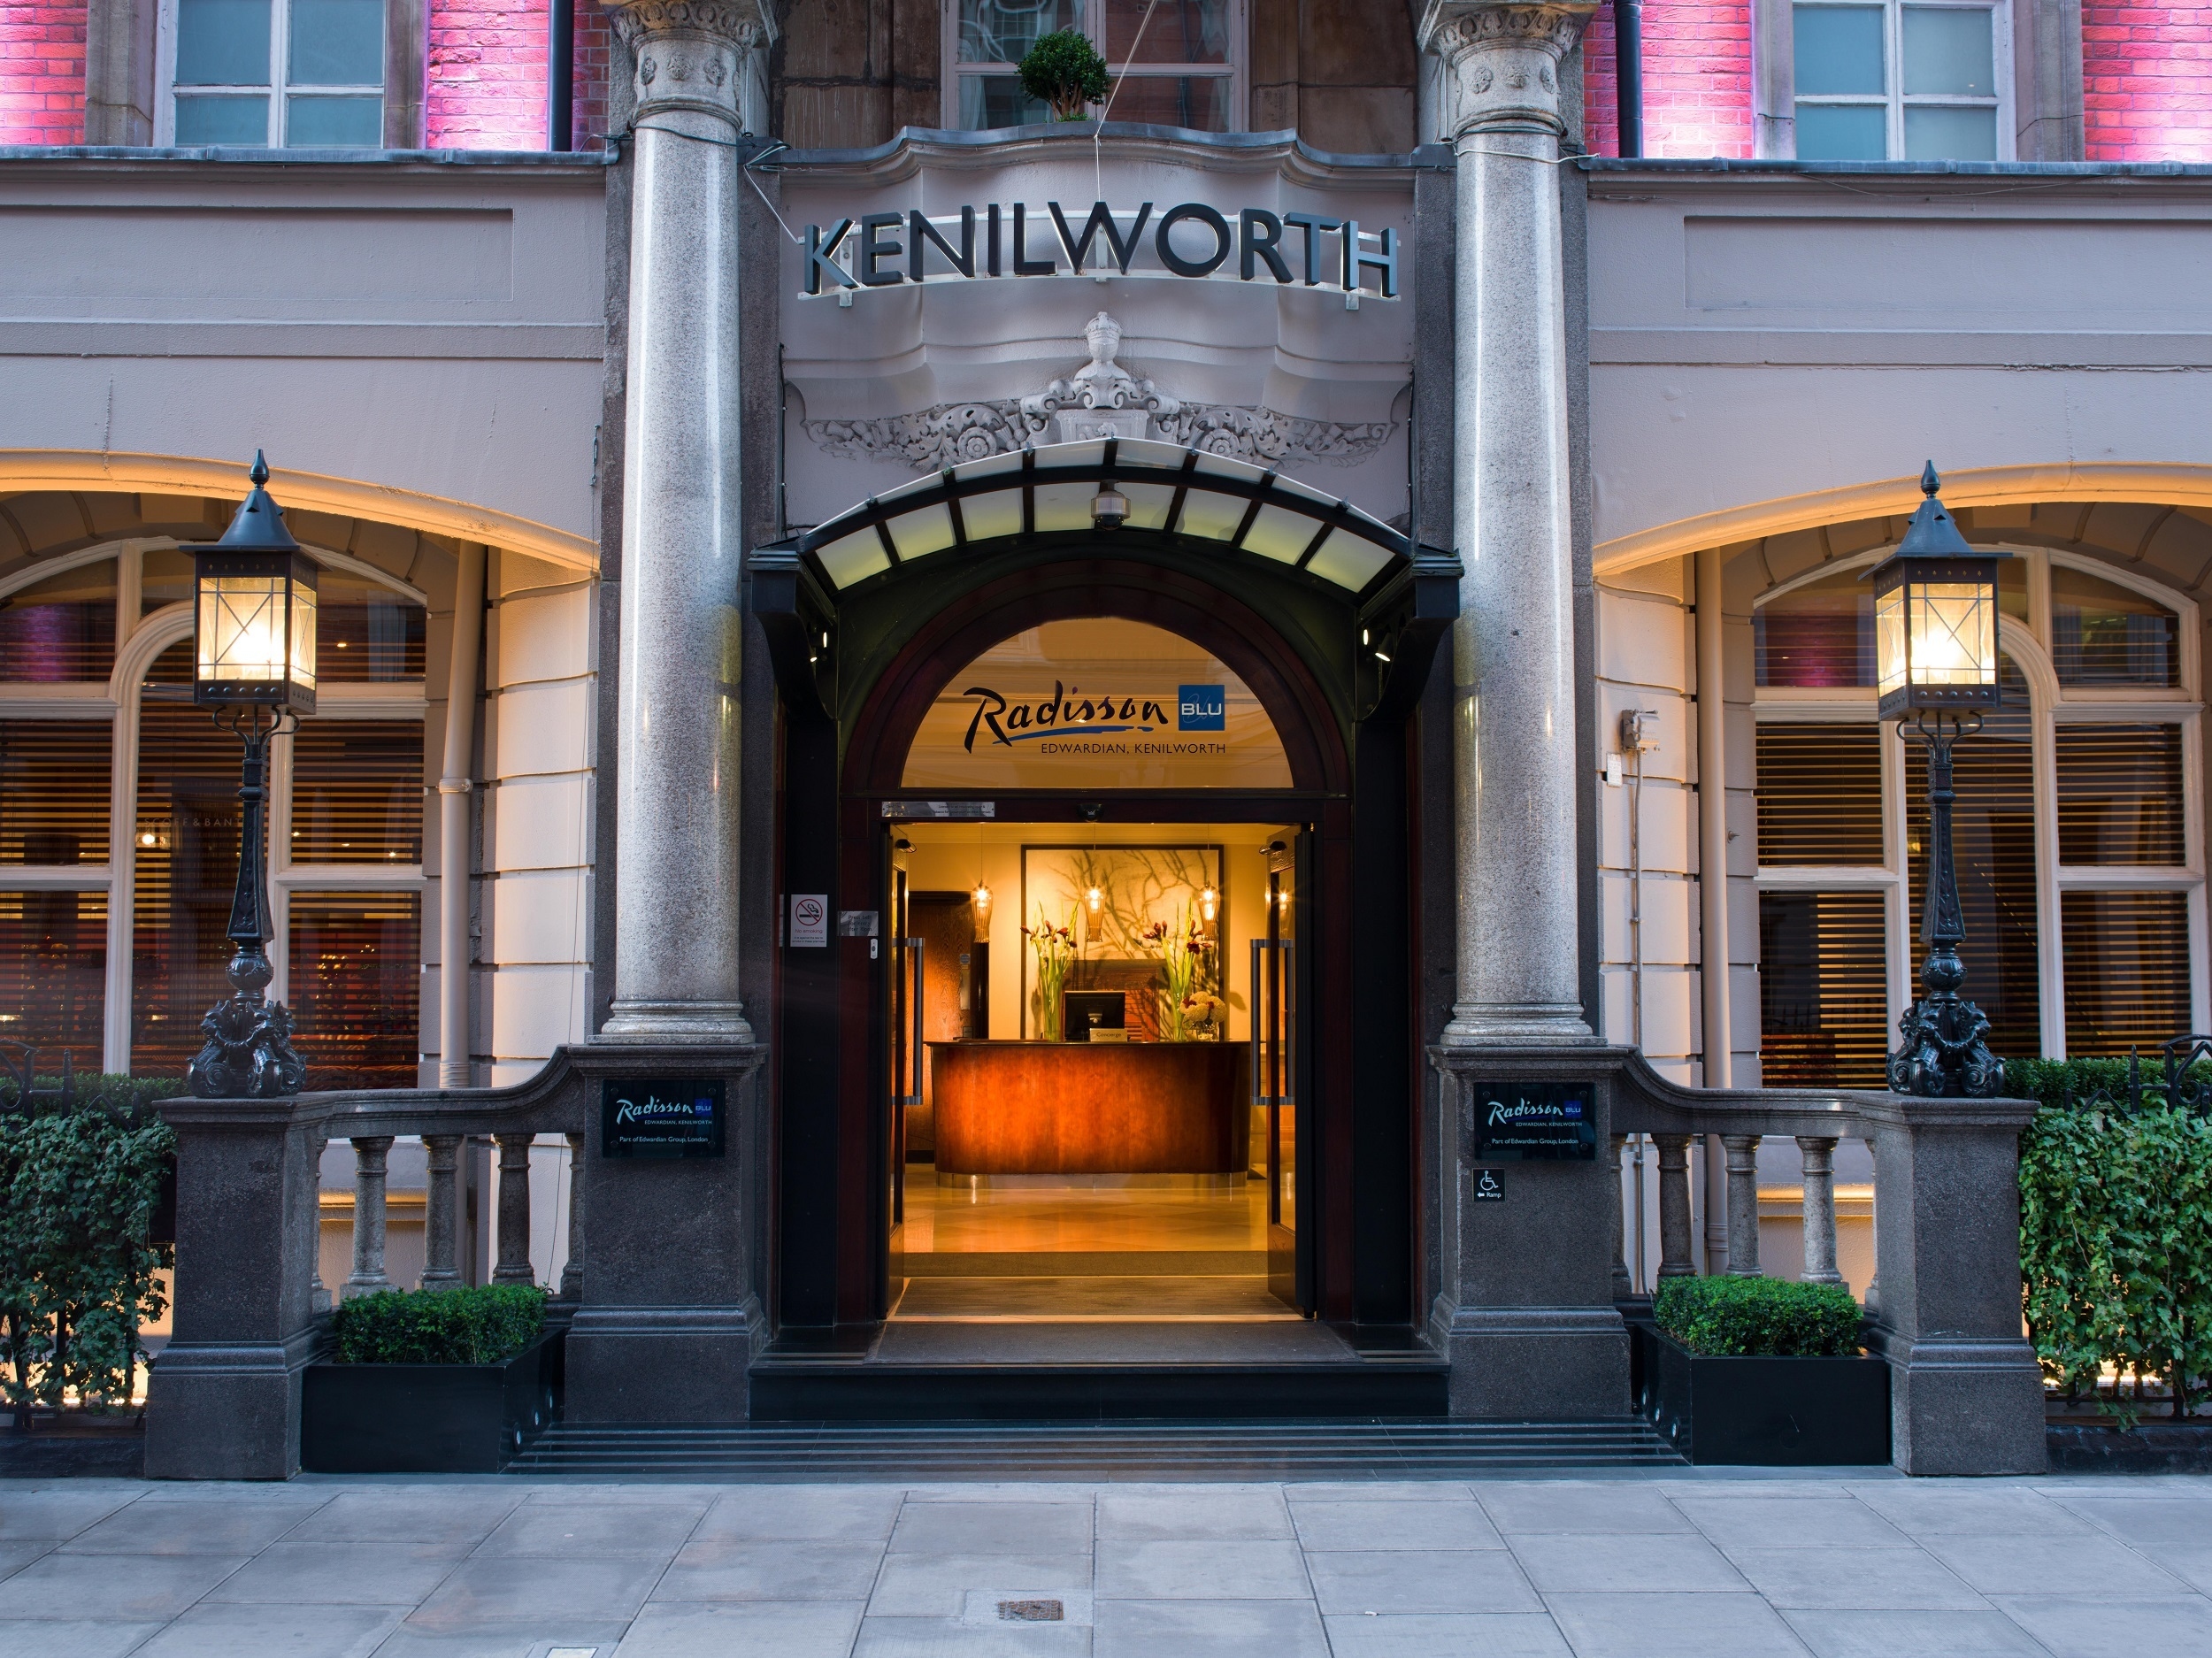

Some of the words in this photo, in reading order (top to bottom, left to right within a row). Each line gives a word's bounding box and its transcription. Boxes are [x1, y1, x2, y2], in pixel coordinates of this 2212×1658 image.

[804, 201, 1399, 297] KENILWORTH
[963, 679, 1169, 754] Radisson
[1181, 702, 1222, 716] BLU
[1041, 743, 1130, 756] EDWARDIAN,
[1134, 743, 1226, 754] KENILWORTH
[144, 817, 188, 826] SCOFF
[204, 817, 242, 826] BANT
[616, 1095, 694, 1125] Radisson
[1487, 1098, 1563, 1127] Radisson
